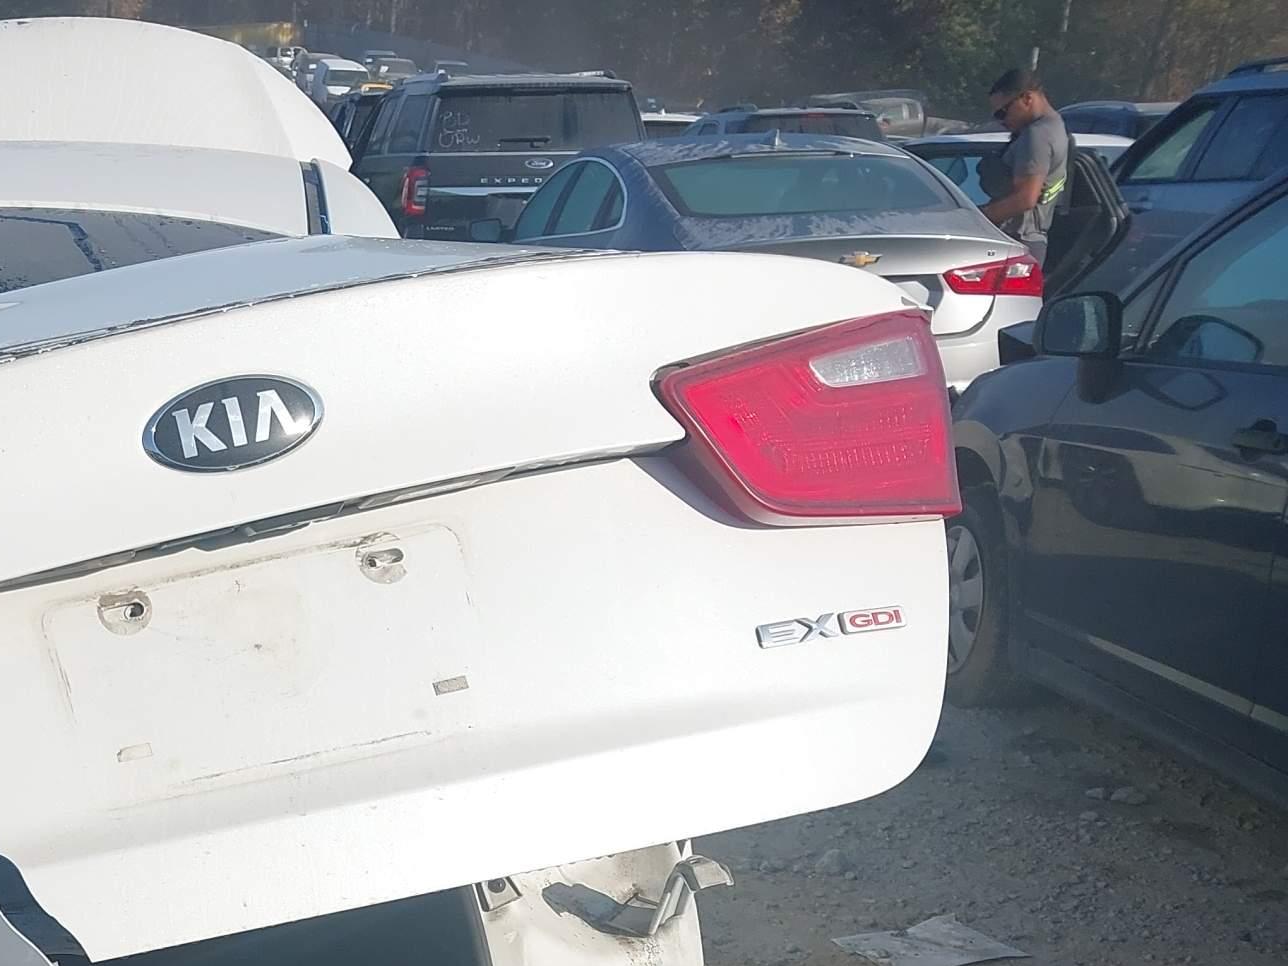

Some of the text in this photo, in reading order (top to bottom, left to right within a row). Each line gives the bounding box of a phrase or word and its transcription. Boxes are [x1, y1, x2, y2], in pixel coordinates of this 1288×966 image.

[172, 389, 304, 459] KIA
[755, 609, 903, 649] EX GDI
